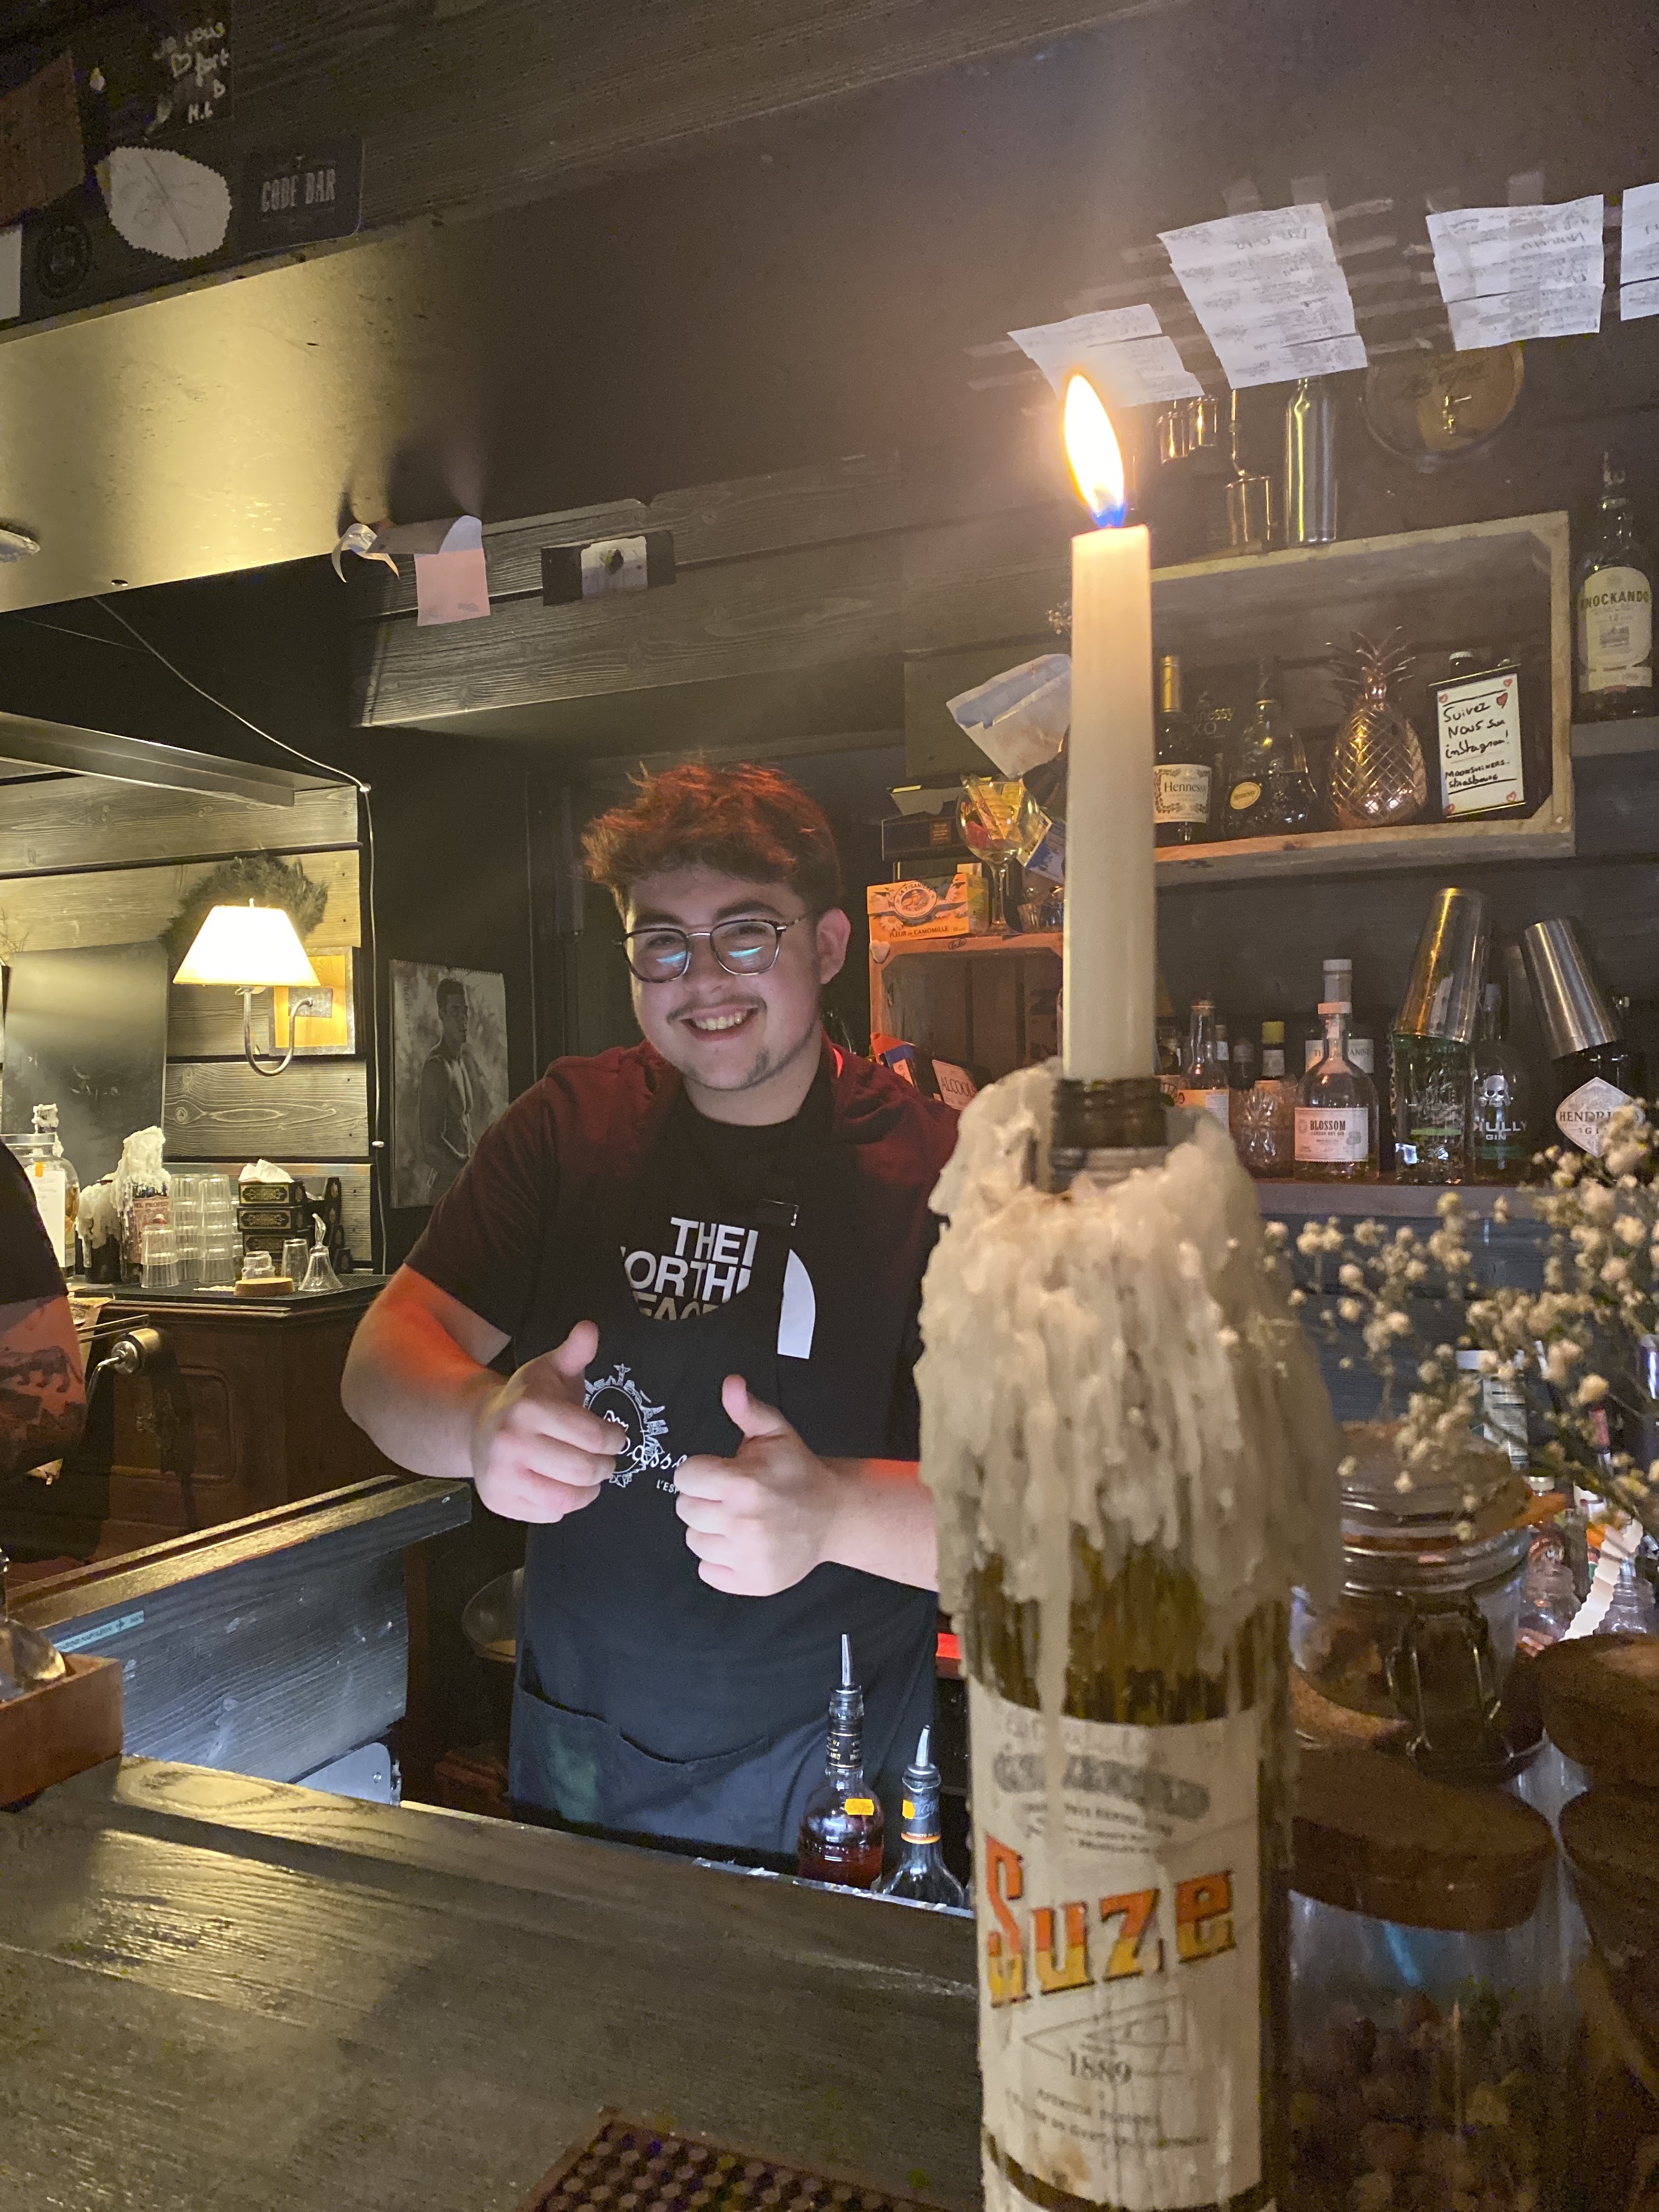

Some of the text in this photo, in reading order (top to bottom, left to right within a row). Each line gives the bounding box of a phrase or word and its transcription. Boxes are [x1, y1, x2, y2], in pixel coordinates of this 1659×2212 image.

[261, 168, 336, 212] CODE BAR
[913, 926, 949, 935] CAMOMILLE
[1310, 1120, 1346, 1130] BLOSSOM
[670, 1216, 746, 1265] THE
[620, 1246, 737, 1304] ORTH
[985, 1833, 1238, 2009] Suze
[1069, 2051, 1132, 2085] 1889
